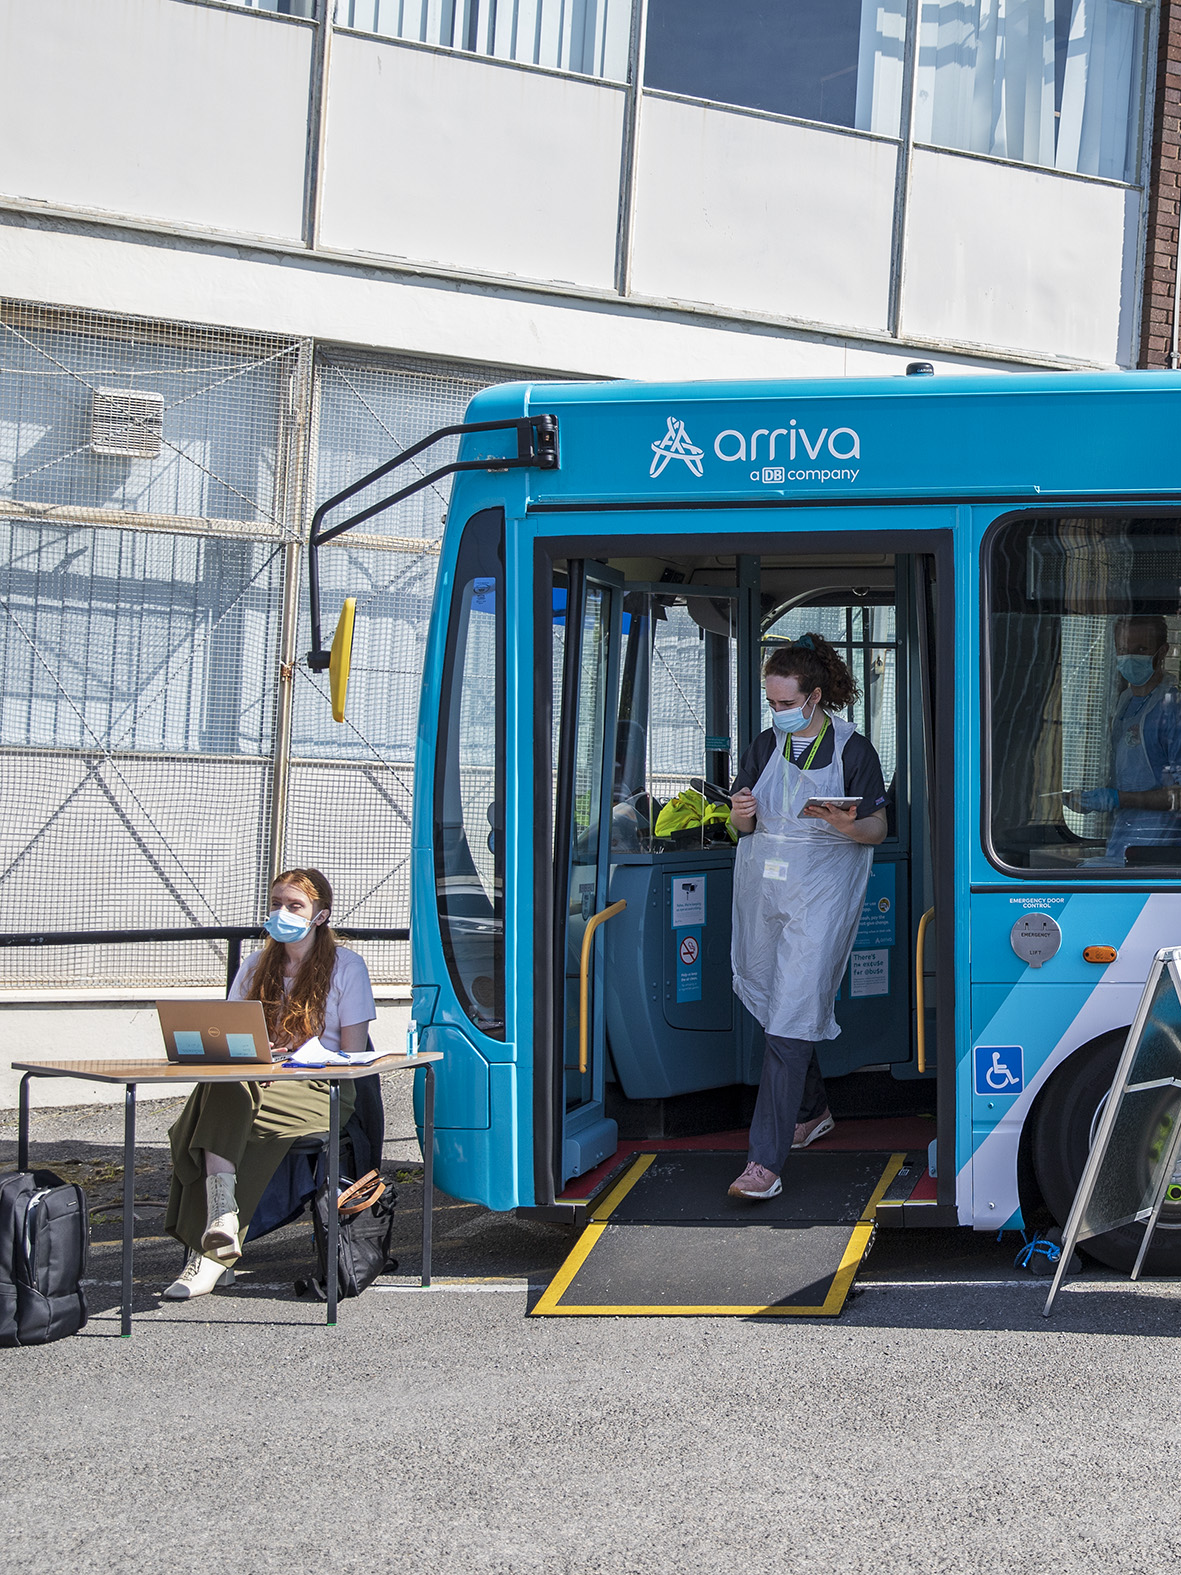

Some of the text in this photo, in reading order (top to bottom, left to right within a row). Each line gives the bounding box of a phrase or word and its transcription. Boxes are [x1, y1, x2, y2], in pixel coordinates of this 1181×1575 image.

[713, 418, 861, 462] arriva
[749, 467, 860, 483] a DB company
